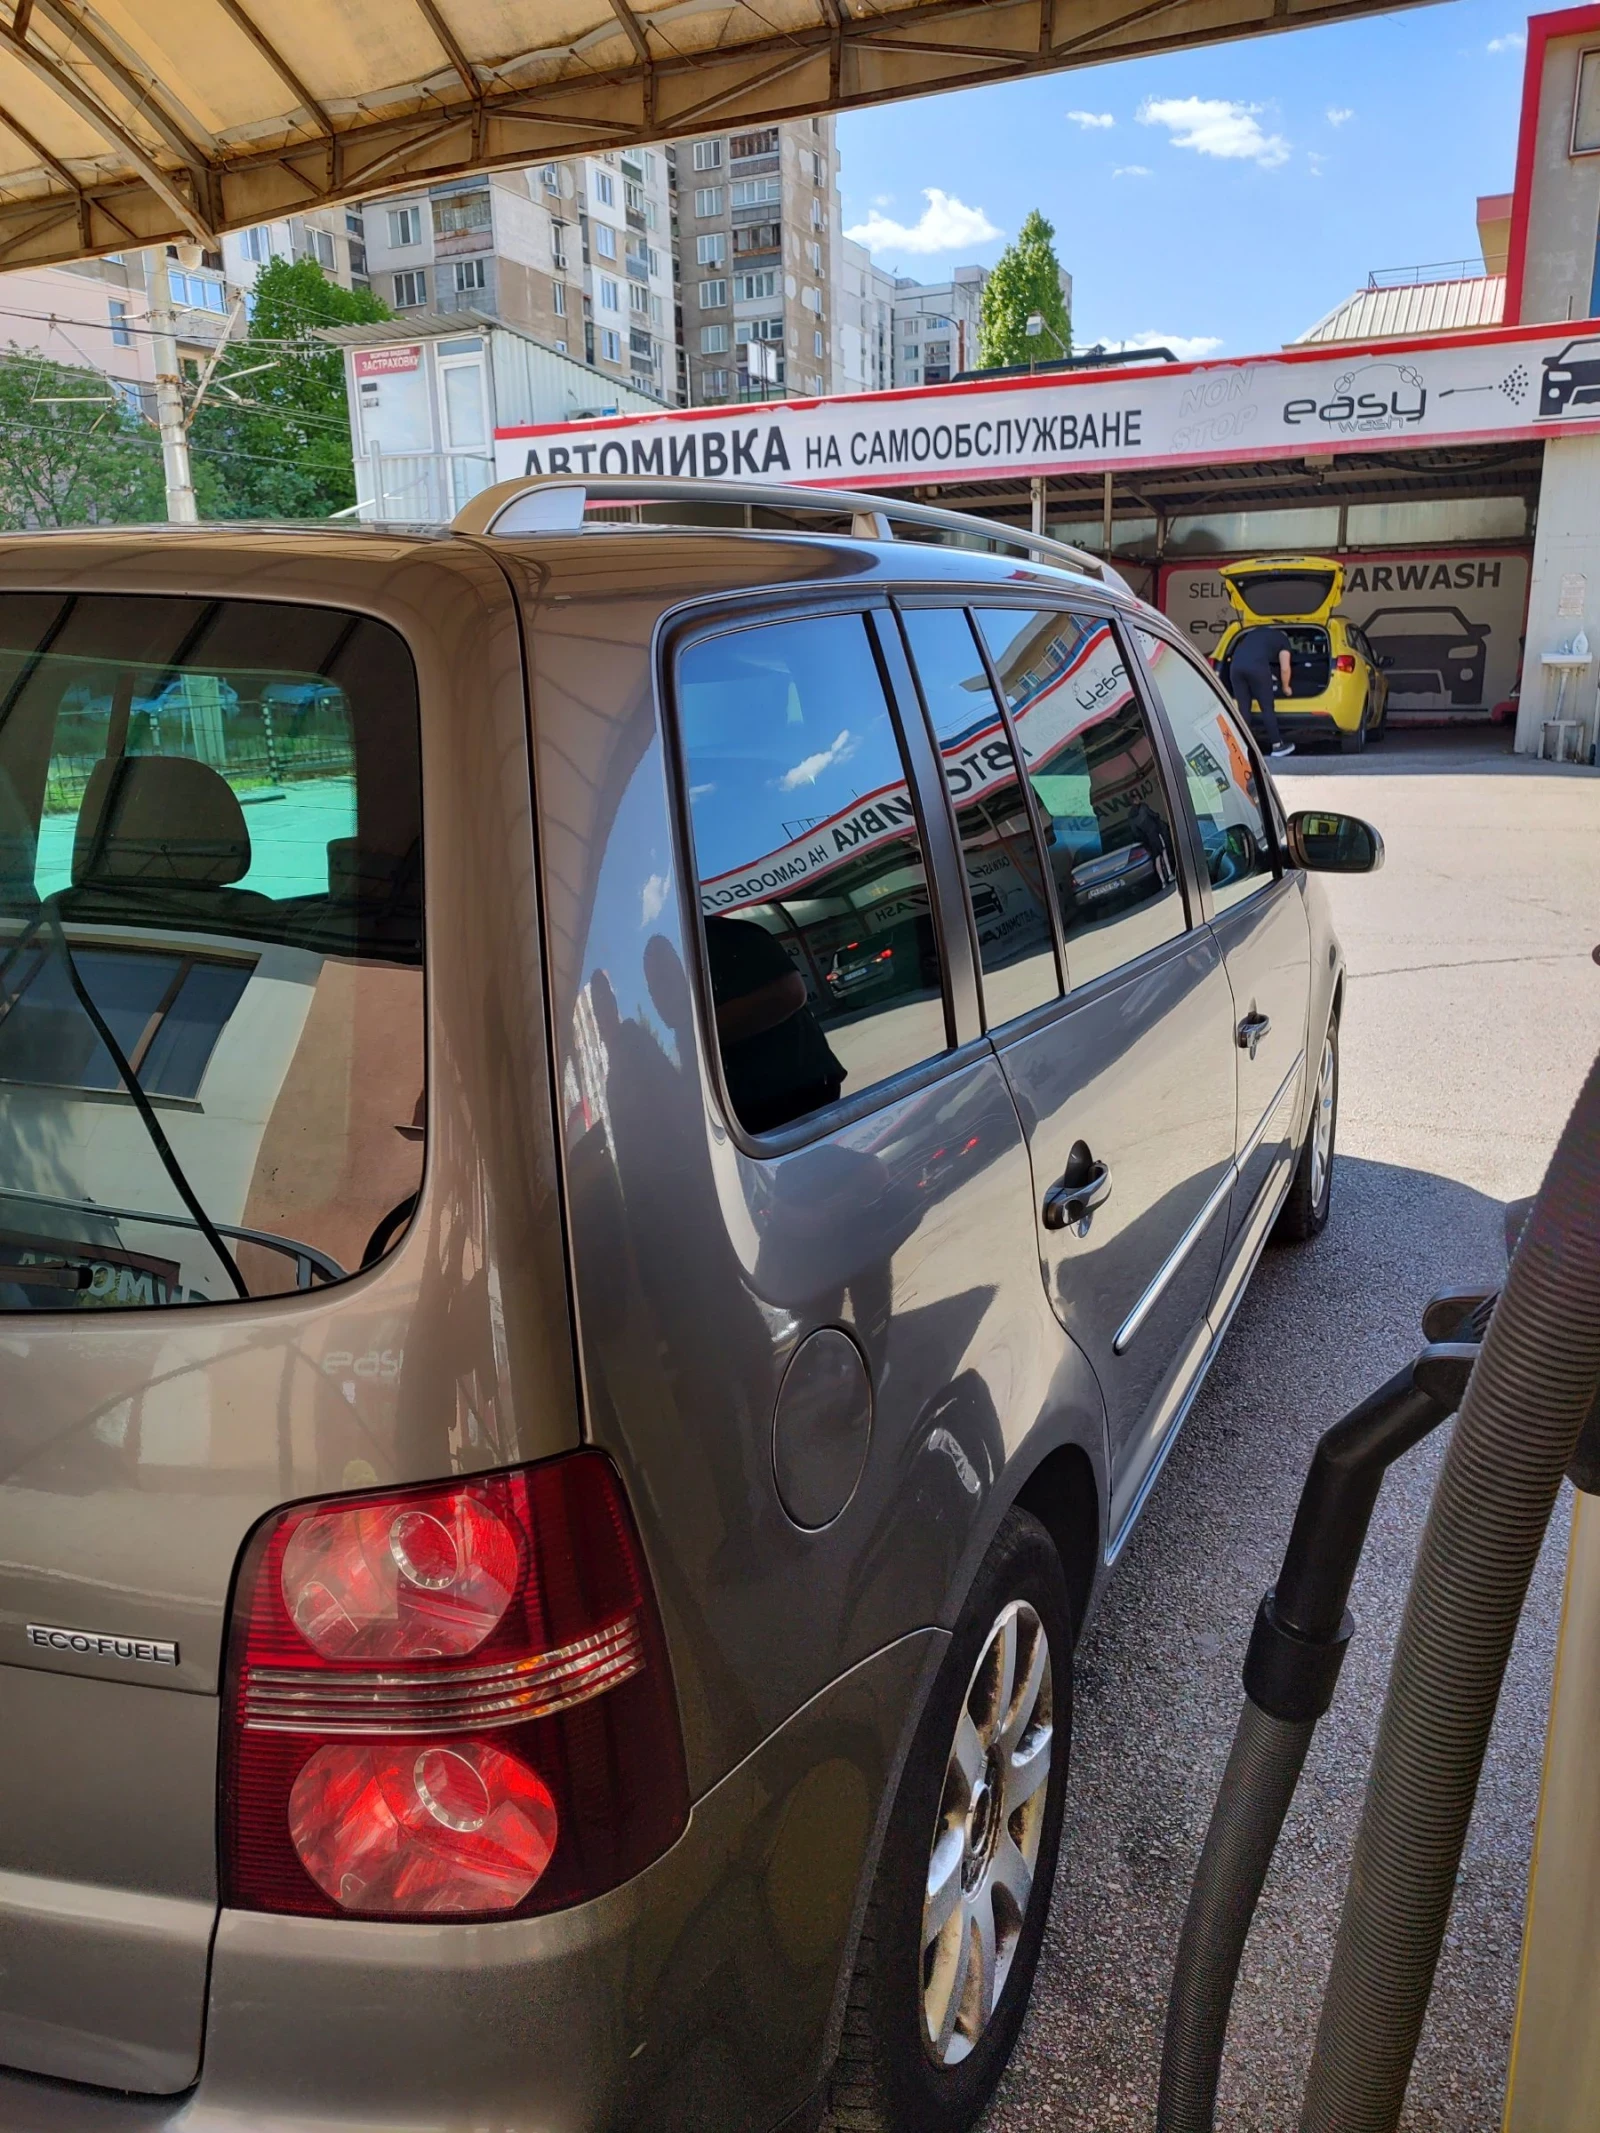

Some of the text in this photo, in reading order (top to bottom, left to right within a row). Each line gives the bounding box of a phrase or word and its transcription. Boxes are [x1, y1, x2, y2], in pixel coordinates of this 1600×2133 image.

[1179, 367, 1259, 419] NON
[1283, 388, 1427, 425] easy
[1337, 415, 1405, 433] wash
[525, 409, 1142, 477] АВТОМИВКА НА САМООБСЛУЖВАНЕ
[1346, 562, 1502, 592] ARWASH
